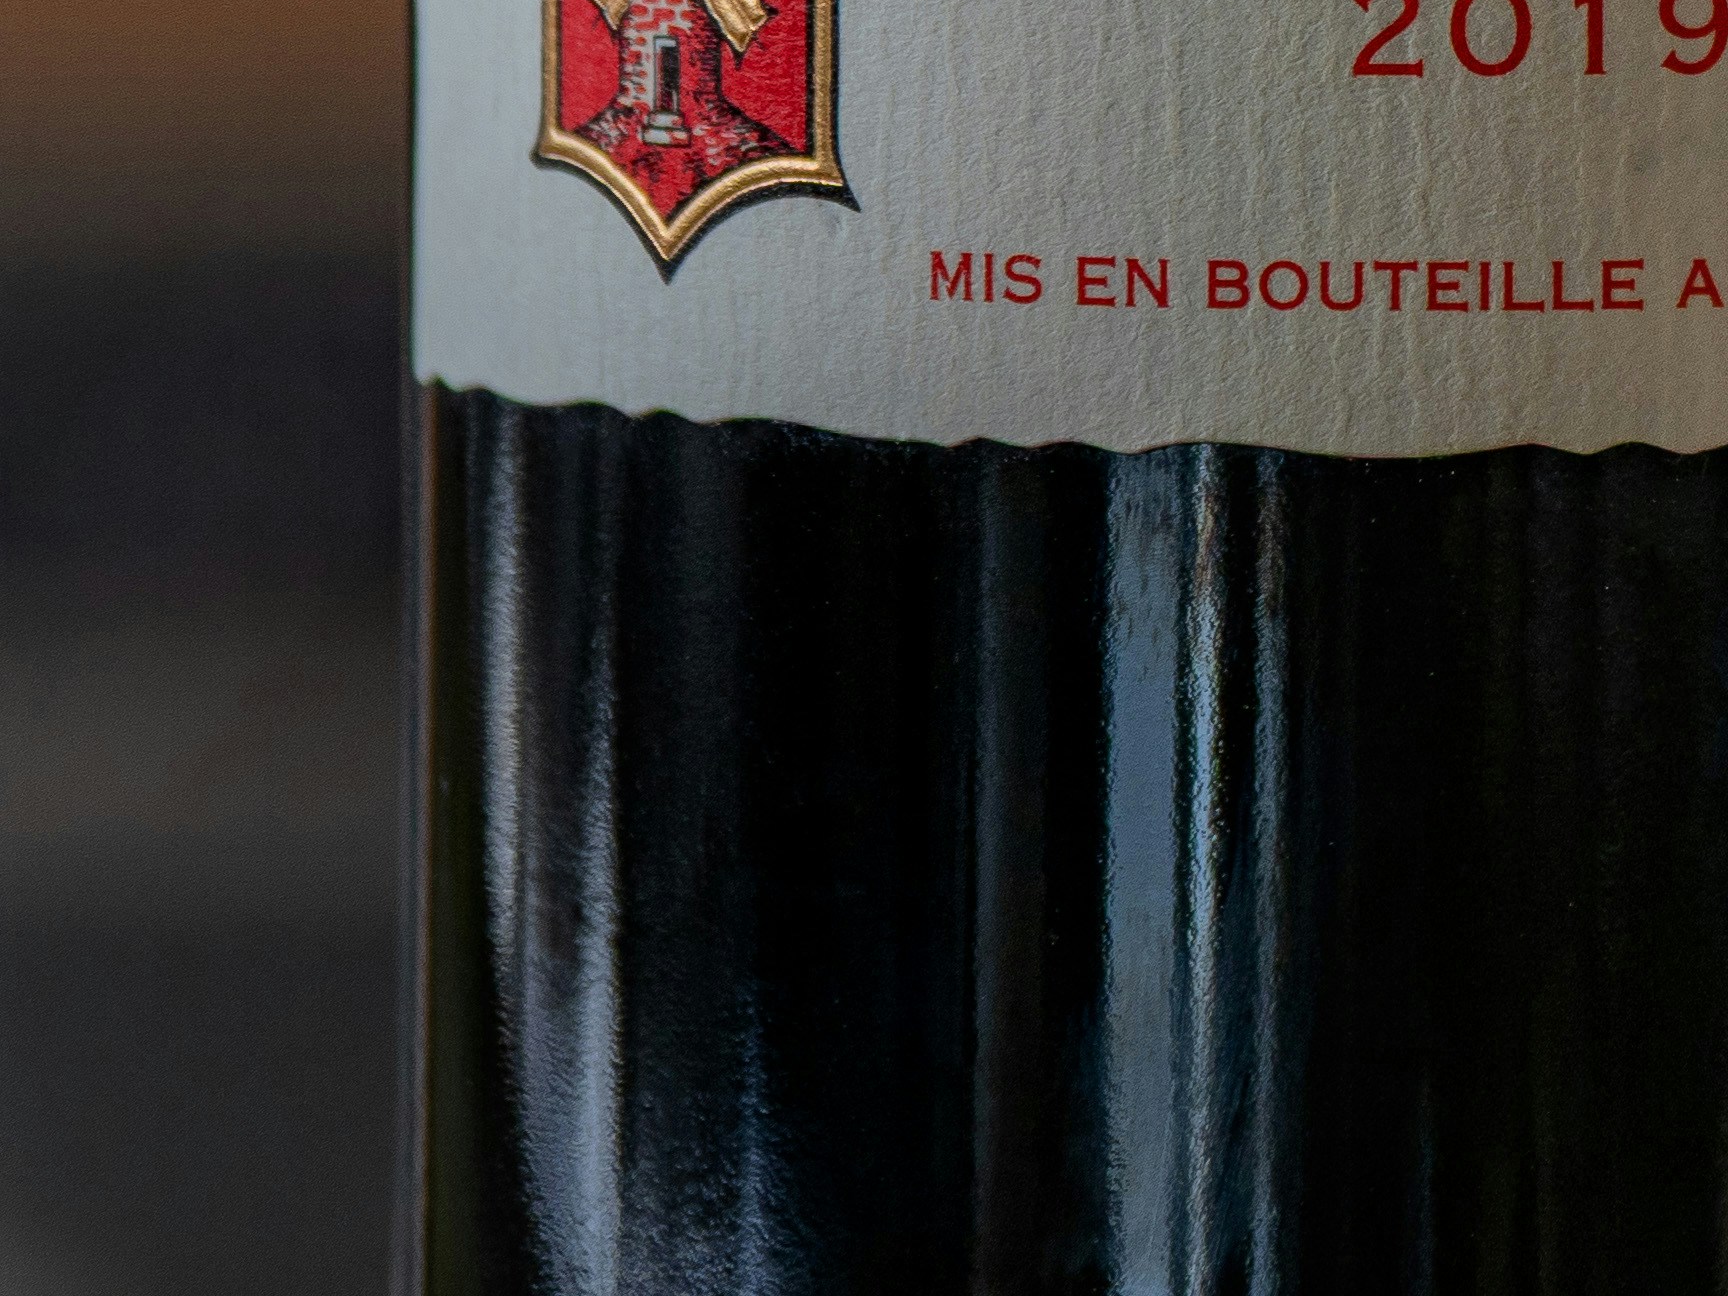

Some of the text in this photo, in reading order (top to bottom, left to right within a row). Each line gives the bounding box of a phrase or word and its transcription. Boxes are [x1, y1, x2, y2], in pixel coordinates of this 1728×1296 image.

[931, 251, 1043, 304] MIS
[1076, 256, 1169, 308] EN
[1207, 259, 1644, 312] BOUTEILLE
